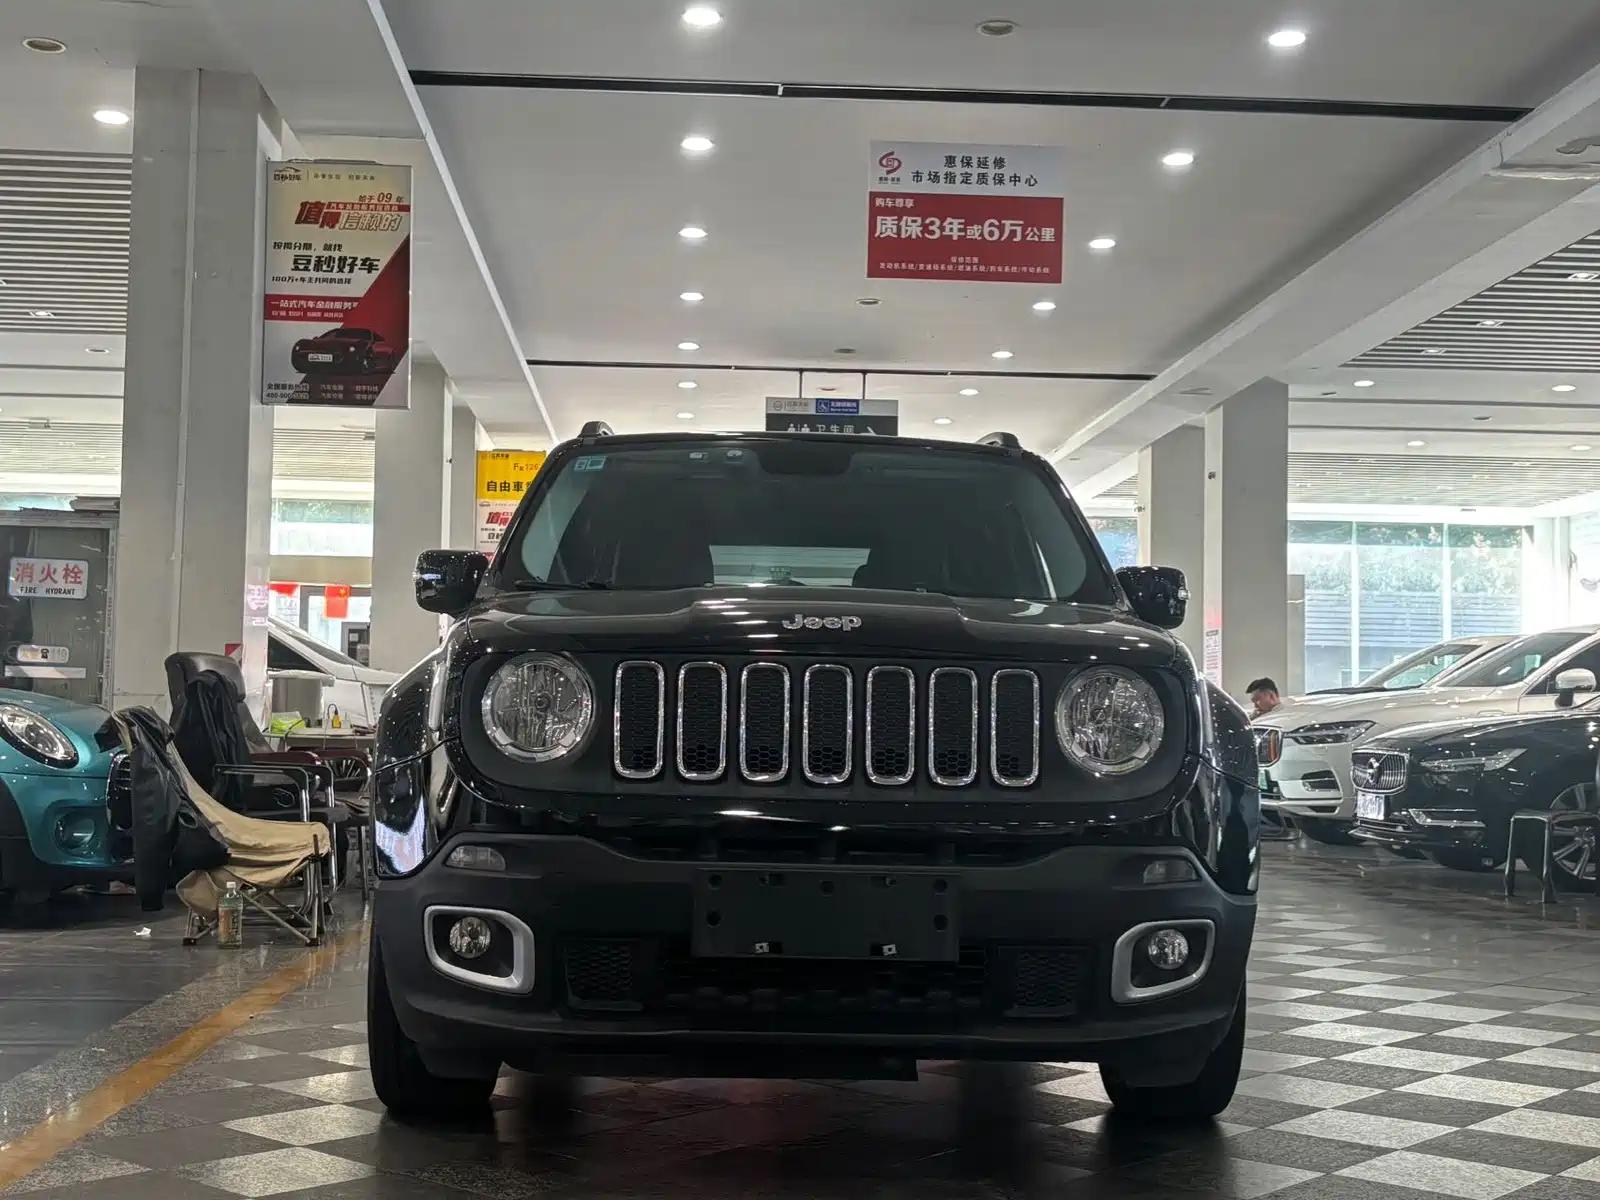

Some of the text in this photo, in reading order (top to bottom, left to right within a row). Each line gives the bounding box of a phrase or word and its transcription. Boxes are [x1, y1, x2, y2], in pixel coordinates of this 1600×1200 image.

[944, 155, 1007, 170] 惠保延修
[911, 170, 1039, 187] 市场指定质保中心
[875, 198, 914, 208] 购车尊享
[875, 216, 1056, 242] 质保3年或6万公里
[291, 254, 381, 274] 豆秒好车
[816, 424, 854, 434] 卫生间
[14, 562, 83, 584] 消火栓
[20, 586, 37, 594] FIRE
[781, 613, 862, 631] Jeep
